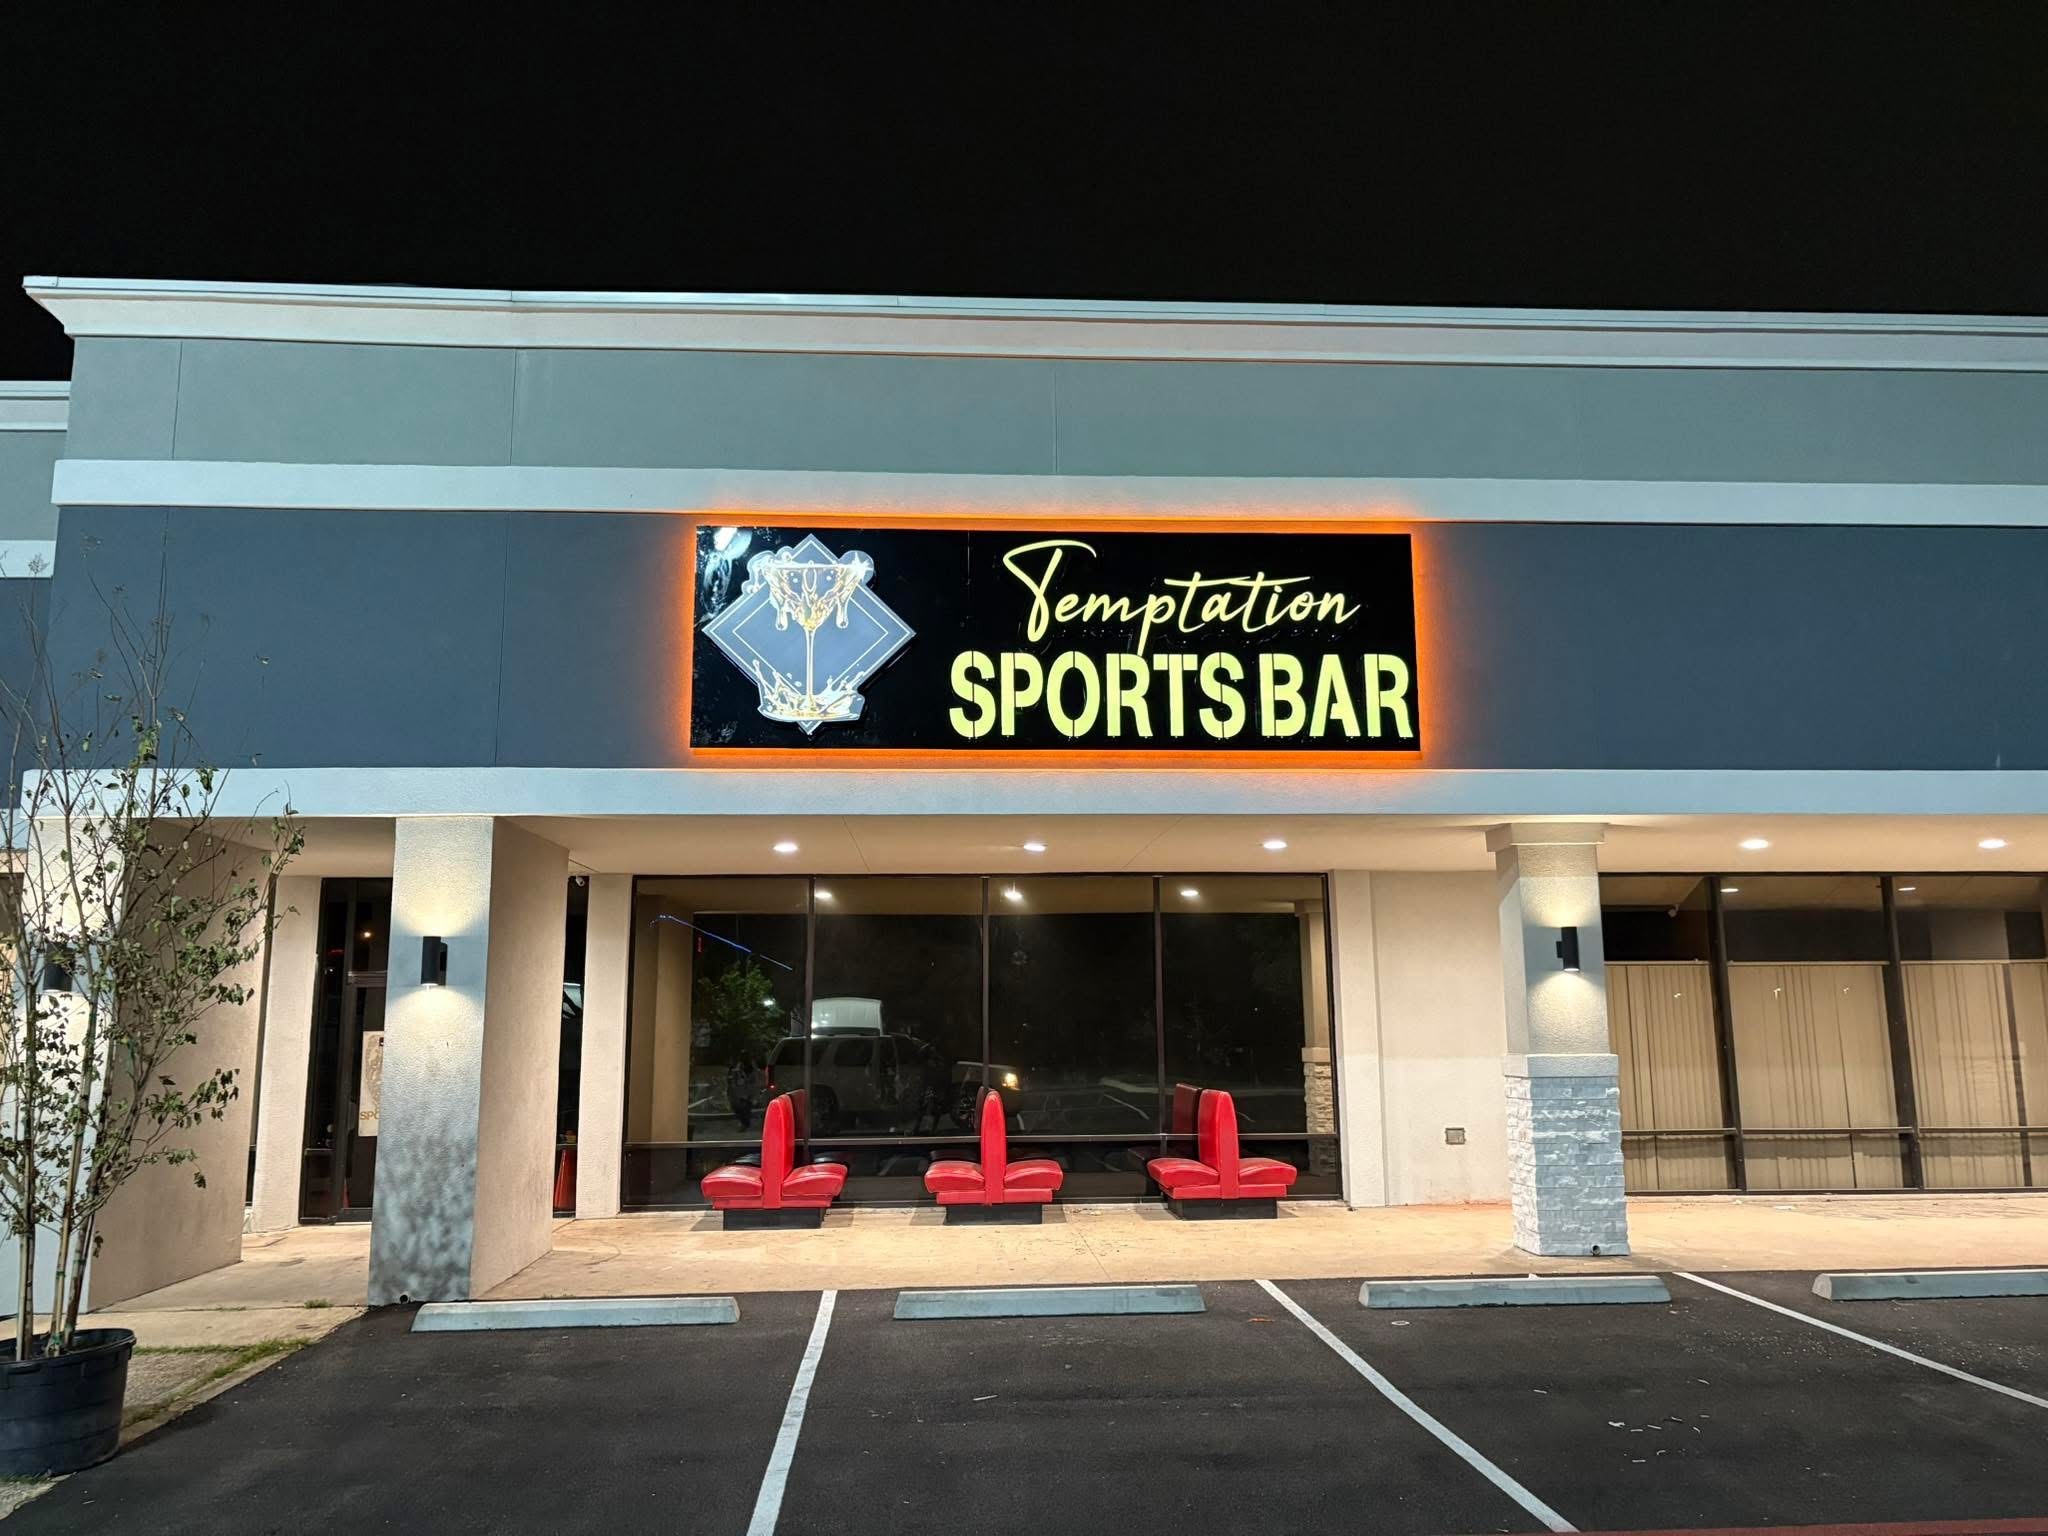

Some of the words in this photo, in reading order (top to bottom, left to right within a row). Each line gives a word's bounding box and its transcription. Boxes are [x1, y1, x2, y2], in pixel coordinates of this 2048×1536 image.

[1002, 539, 1361, 653] Temptation
[949, 650, 1246, 740] SPORTS
[1258, 652, 1414, 740] BAR
